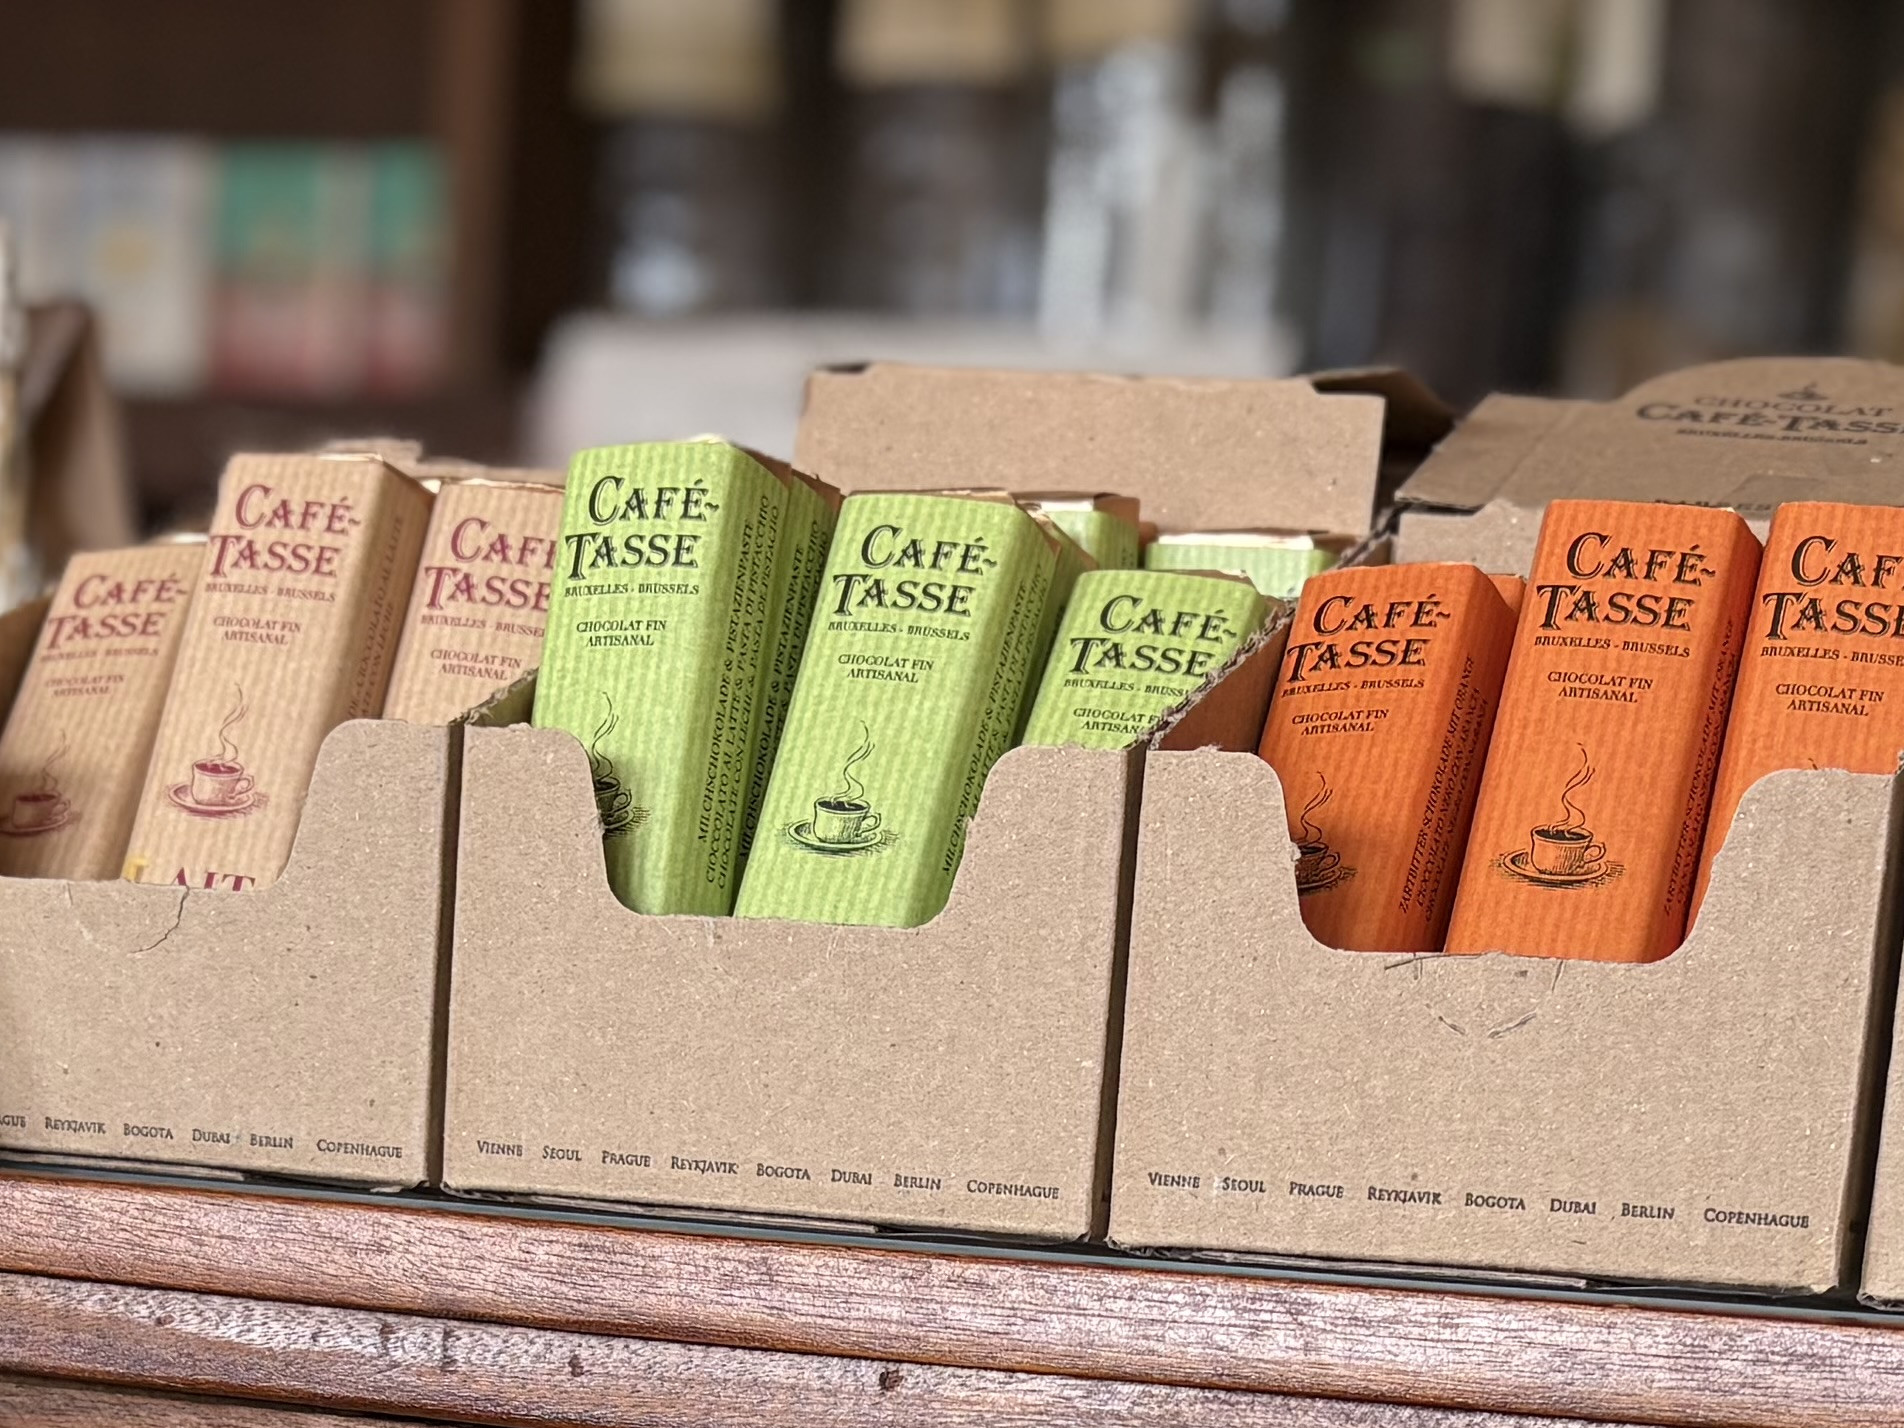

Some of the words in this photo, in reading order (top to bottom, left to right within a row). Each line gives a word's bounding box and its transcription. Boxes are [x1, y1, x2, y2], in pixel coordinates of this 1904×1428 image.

[209, 535, 342, 578] TASSE
[565, 532, 702, 581] TASSE
[564, 583, 628, 597] BRUXELLES
[638, 583, 699, 595] BRUSSELS
[832, 573, 976, 618] TASSE
[1536, 584, 1695, 633] TASSE
[576, 620, 644, 633] CHOCOLAT
[646, 620, 667, 630] FIN
[586, 634, 655, 647] ARTISANAL
[1070, 636, 1216, 679] TASSE
[1287, 638, 1431, 683] TASSE
[1534, 635, 1610, 650] BRUXELLES
[1622, 640, 1690, 658] BRUSSELS
[1547, 671, 1625, 689] CHOCOLAT
[1629, 677, 1653, 690] FIN
[1558, 687, 1638, 704] ARTISANAL
